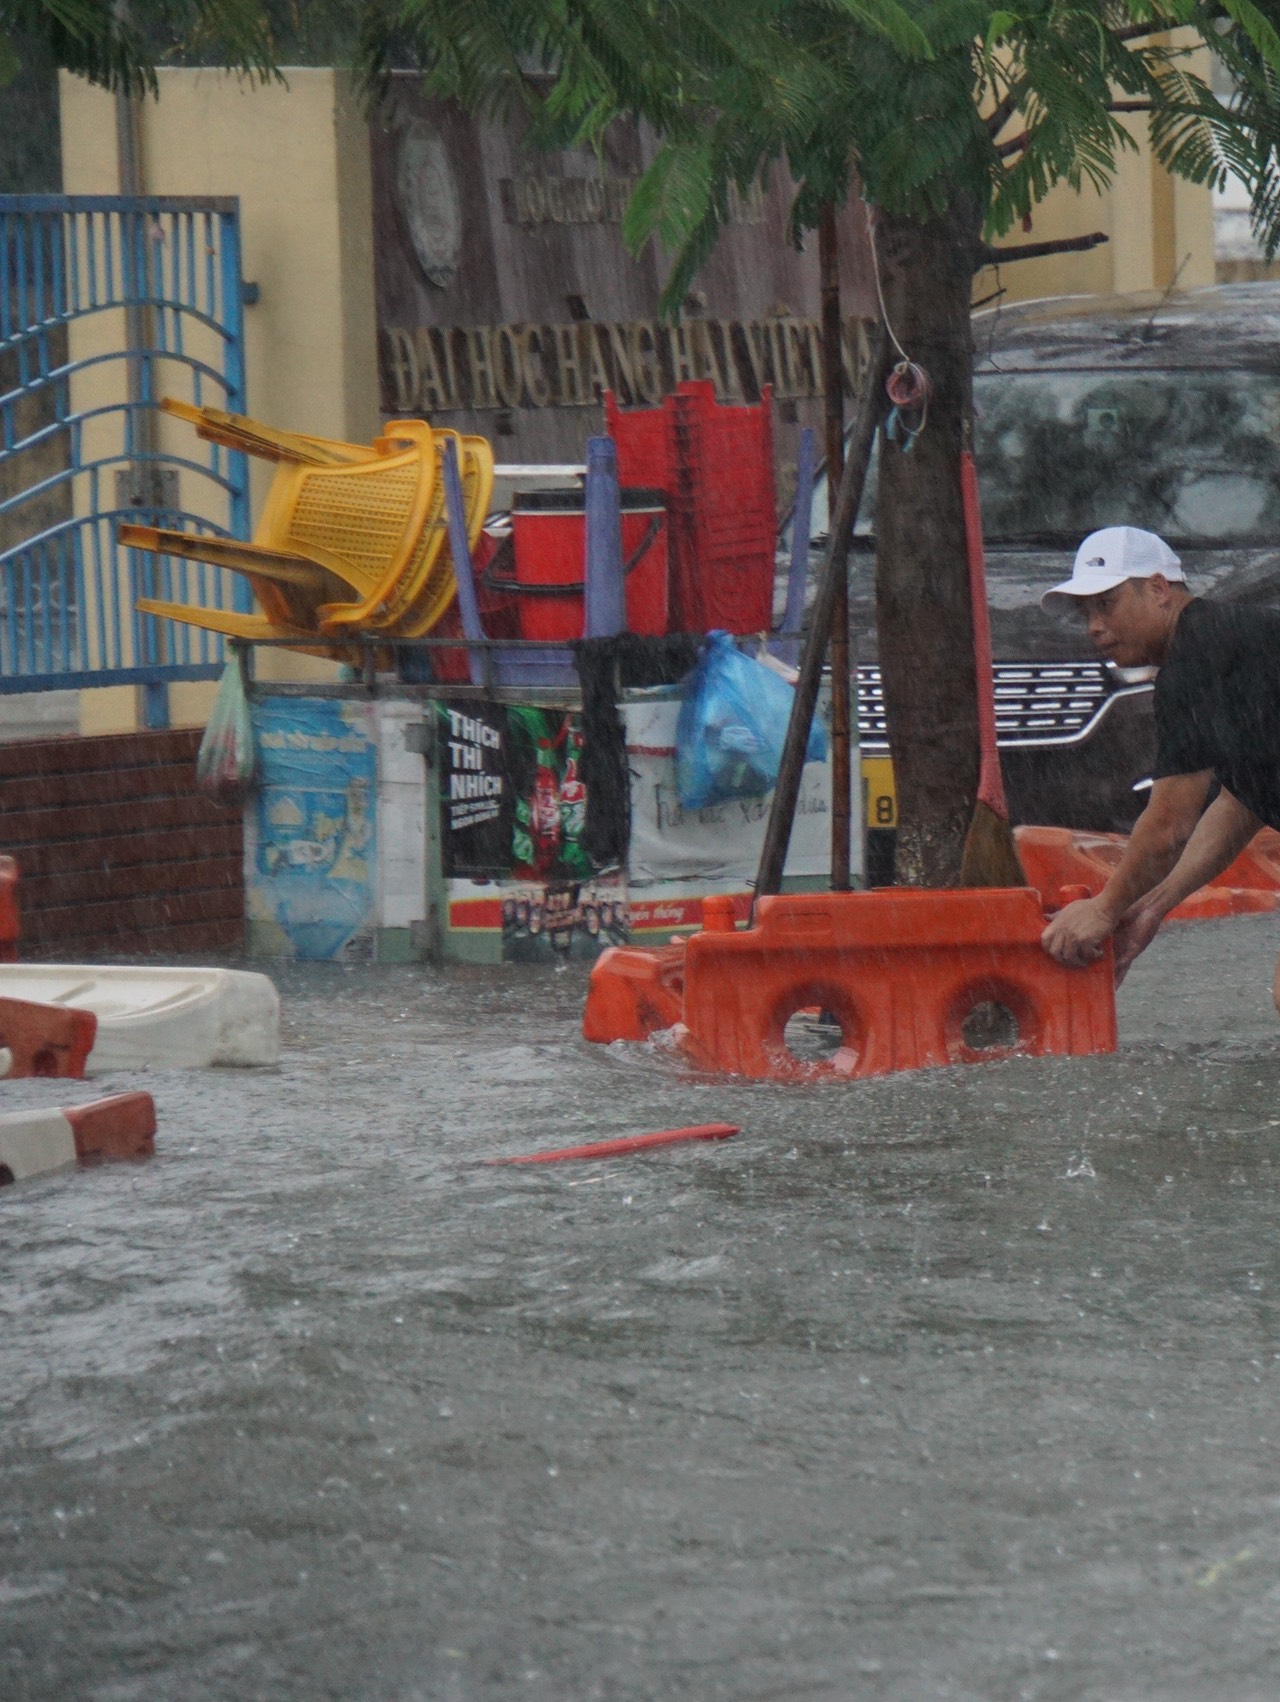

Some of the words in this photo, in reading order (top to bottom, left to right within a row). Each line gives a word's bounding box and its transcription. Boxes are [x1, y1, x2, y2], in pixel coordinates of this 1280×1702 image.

[447, 708, 500, 750] THÍCH
[448, 741, 482, 770] THÌ
[450, 771, 502, 800] NHÍCH
